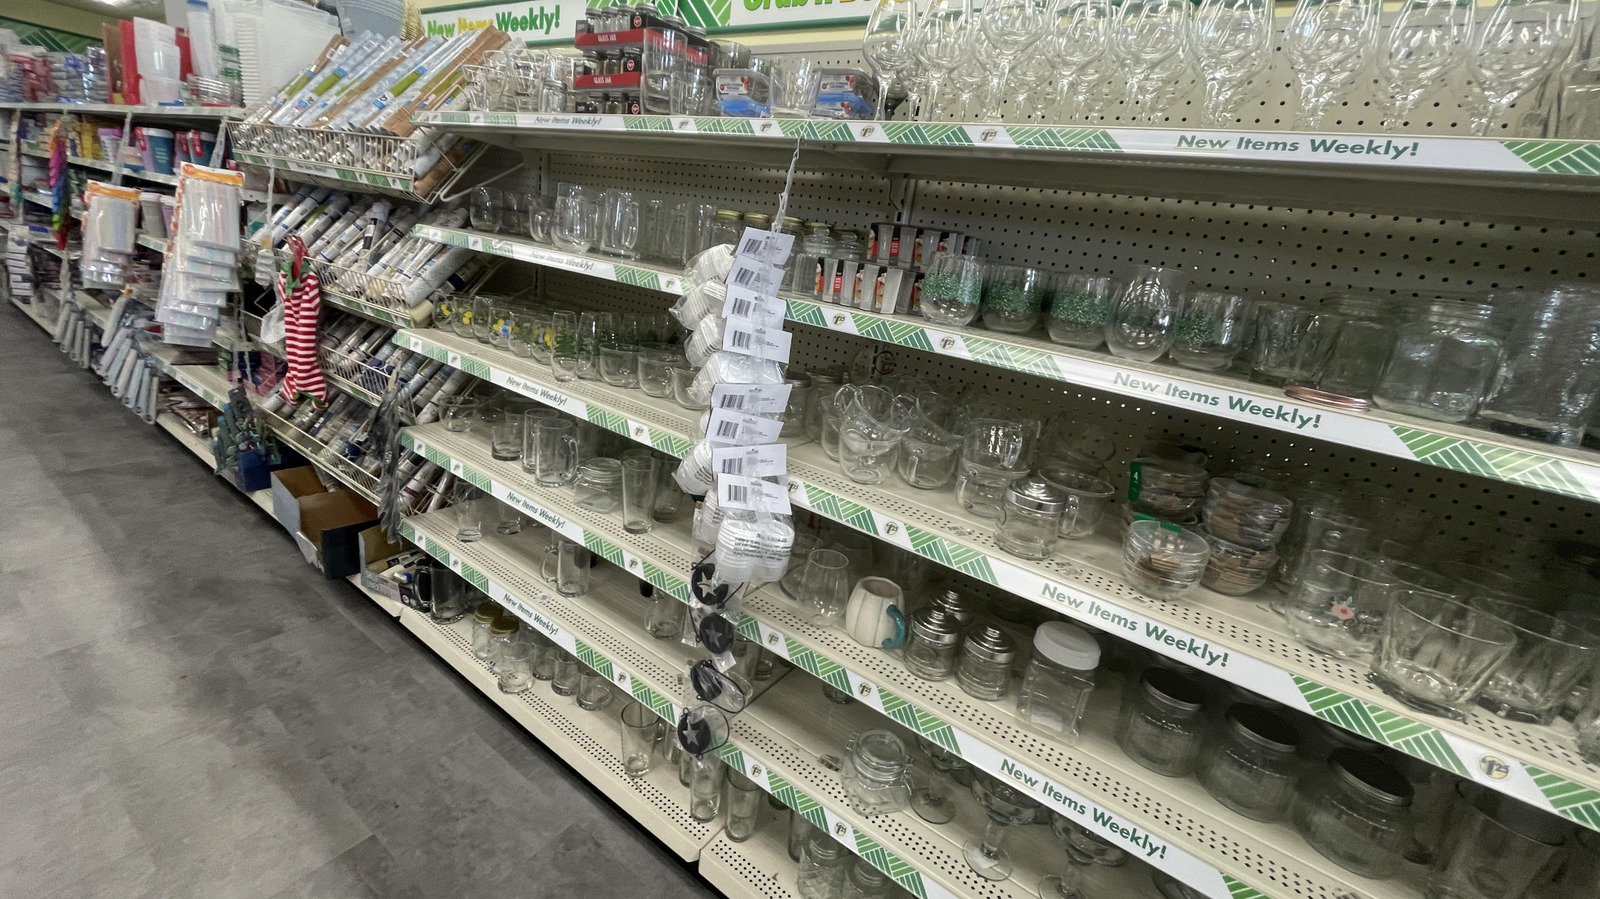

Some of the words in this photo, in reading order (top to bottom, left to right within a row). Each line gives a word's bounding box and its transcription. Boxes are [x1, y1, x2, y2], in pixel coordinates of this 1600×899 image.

[427, 20, 455, 38] New
[495, 4, 560, 35] Weekly!
[572, 116, 602, 127] Weekly!
[1177, 135, 1230, 148] New
[1236, 136, 1300, 151] Items
[1310, 138, 1419, 160] Weekly!
[531, 251, 546, 260] New
[546, 255, 564, 264] Items
[566, 258, 594, 271] Weekly!
[506, 376, 522, 386] New
[522, 382, 538, 394] Items
[540, 388, 567, 406] Weekly!
[1113, 372, 1160, 392] New
[1165, 383, 1220, 406] Items
[1229, 396, 1321, 429] Weekly!
[507, 492, 522, 504] New
[522, 500, 538, 514] Items
[539, 508, 566, 528] Weekly!
[504, 593, 518, 606] New
[518, 602, 532, 618] Items
[534, 614, 558, 635] Weekly!
[1041, 583, 1084, 608] New
[1088, 601, 1138, 631] Items
[1145, 622, 1229, 667] Weekly!
[1000, 759, 1038, 787] New
[1042, 782, 1087, 815] Items
[1092, 808, 1167, 859] Weekly!
